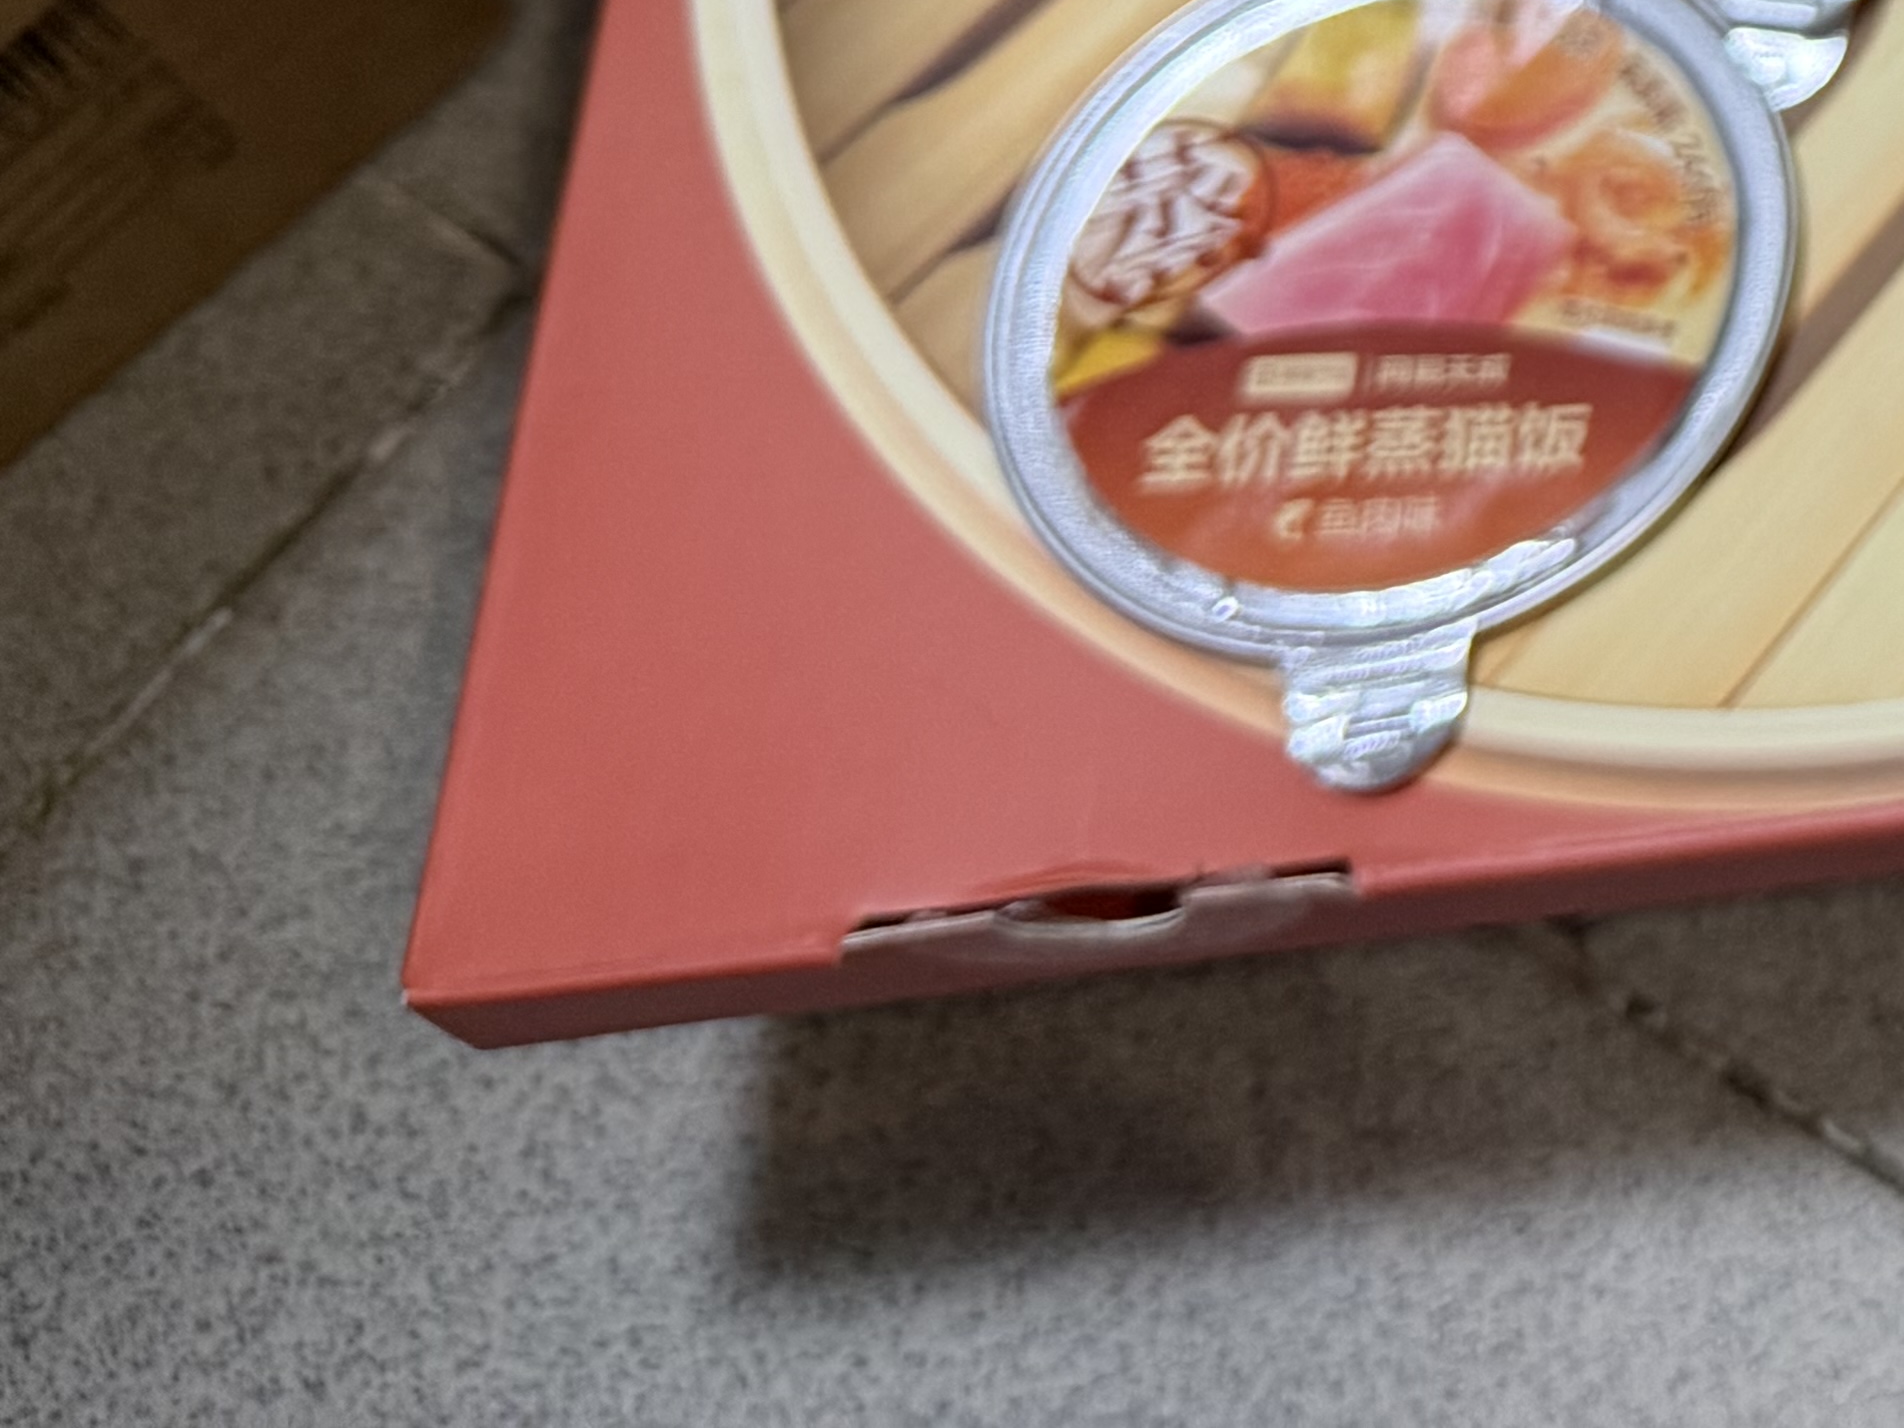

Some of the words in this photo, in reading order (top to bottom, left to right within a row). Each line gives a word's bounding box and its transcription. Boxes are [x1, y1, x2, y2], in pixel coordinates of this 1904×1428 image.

[1140, 402, 1594, 496] 全价鲜蒸猫饭
